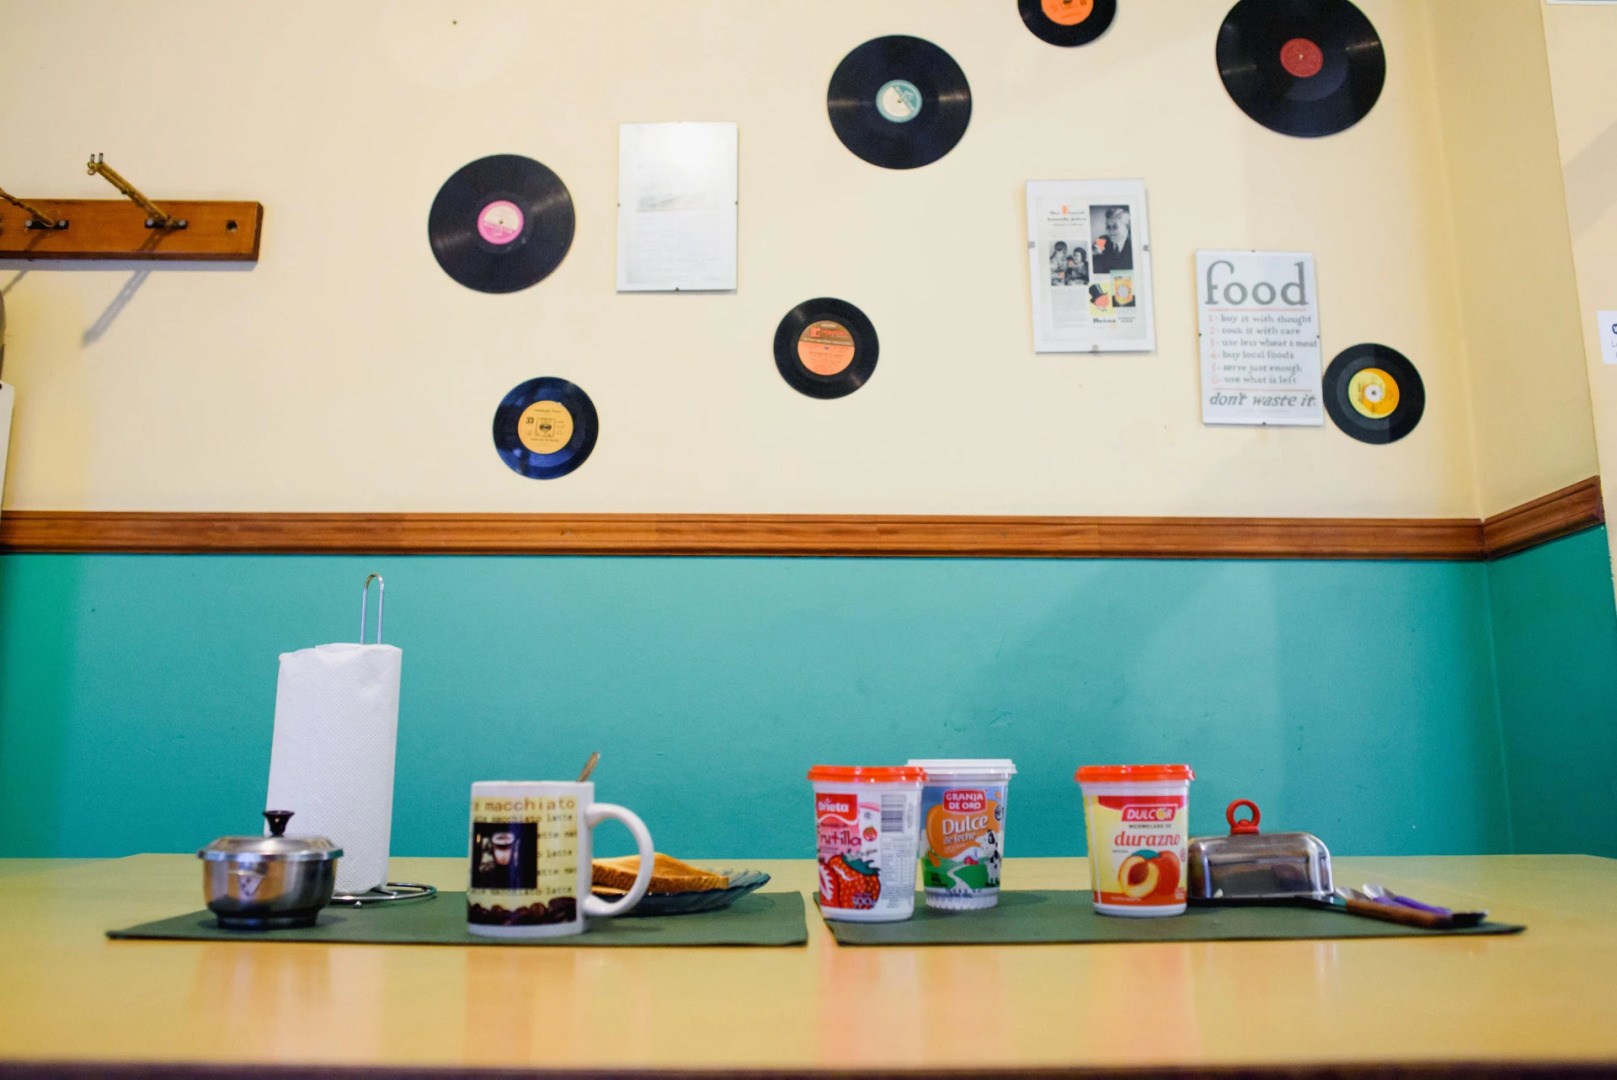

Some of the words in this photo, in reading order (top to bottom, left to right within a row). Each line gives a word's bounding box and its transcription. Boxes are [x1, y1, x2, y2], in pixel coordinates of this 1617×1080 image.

[1204, 259, 1309, 306] food
[1221, 314, 1238, 324] buy
[1241, 315, 1249, 323] it
[1253, 315, 1274, 323] with
[1277, 315, 1312, 327] thought
[1221, 327, 1243, 335] cook
[1246, 327, 1253, 335] it
[1256, 327, 1278, 335] with
[1221, 339, 1238, 347] use
[1240, 339, 1257, 347] less
[1259, 339, 1287, 347] wheat
[1296, 340, 1318, 348] meat
[1222, 350, 1241, 360] buy
[1242, 350, 1265, 359] local
[1267, 350, 1295, 359] foods
[1249, 364, 1268, 375] just
[1270, 363, 1303, 376] enough
[1243, 376, 1266, 384] what
[1269, 376, 1276, 384] is
[1279, 376, 1297, 384] left
[1252, 394, 1297, 407] waste
[945, 792, 984, 802] GRANJA
[485, 796, 576, 811] macchiato
[949, 801, 960, 810] DE
[961, 801, 982, 810] ORO
[942, 815, 988, 836] Dulce
[943, 837, 953, 845] de
[954, 833, 976, 843] leche
[1114, 830, 1181, 847] durazno
